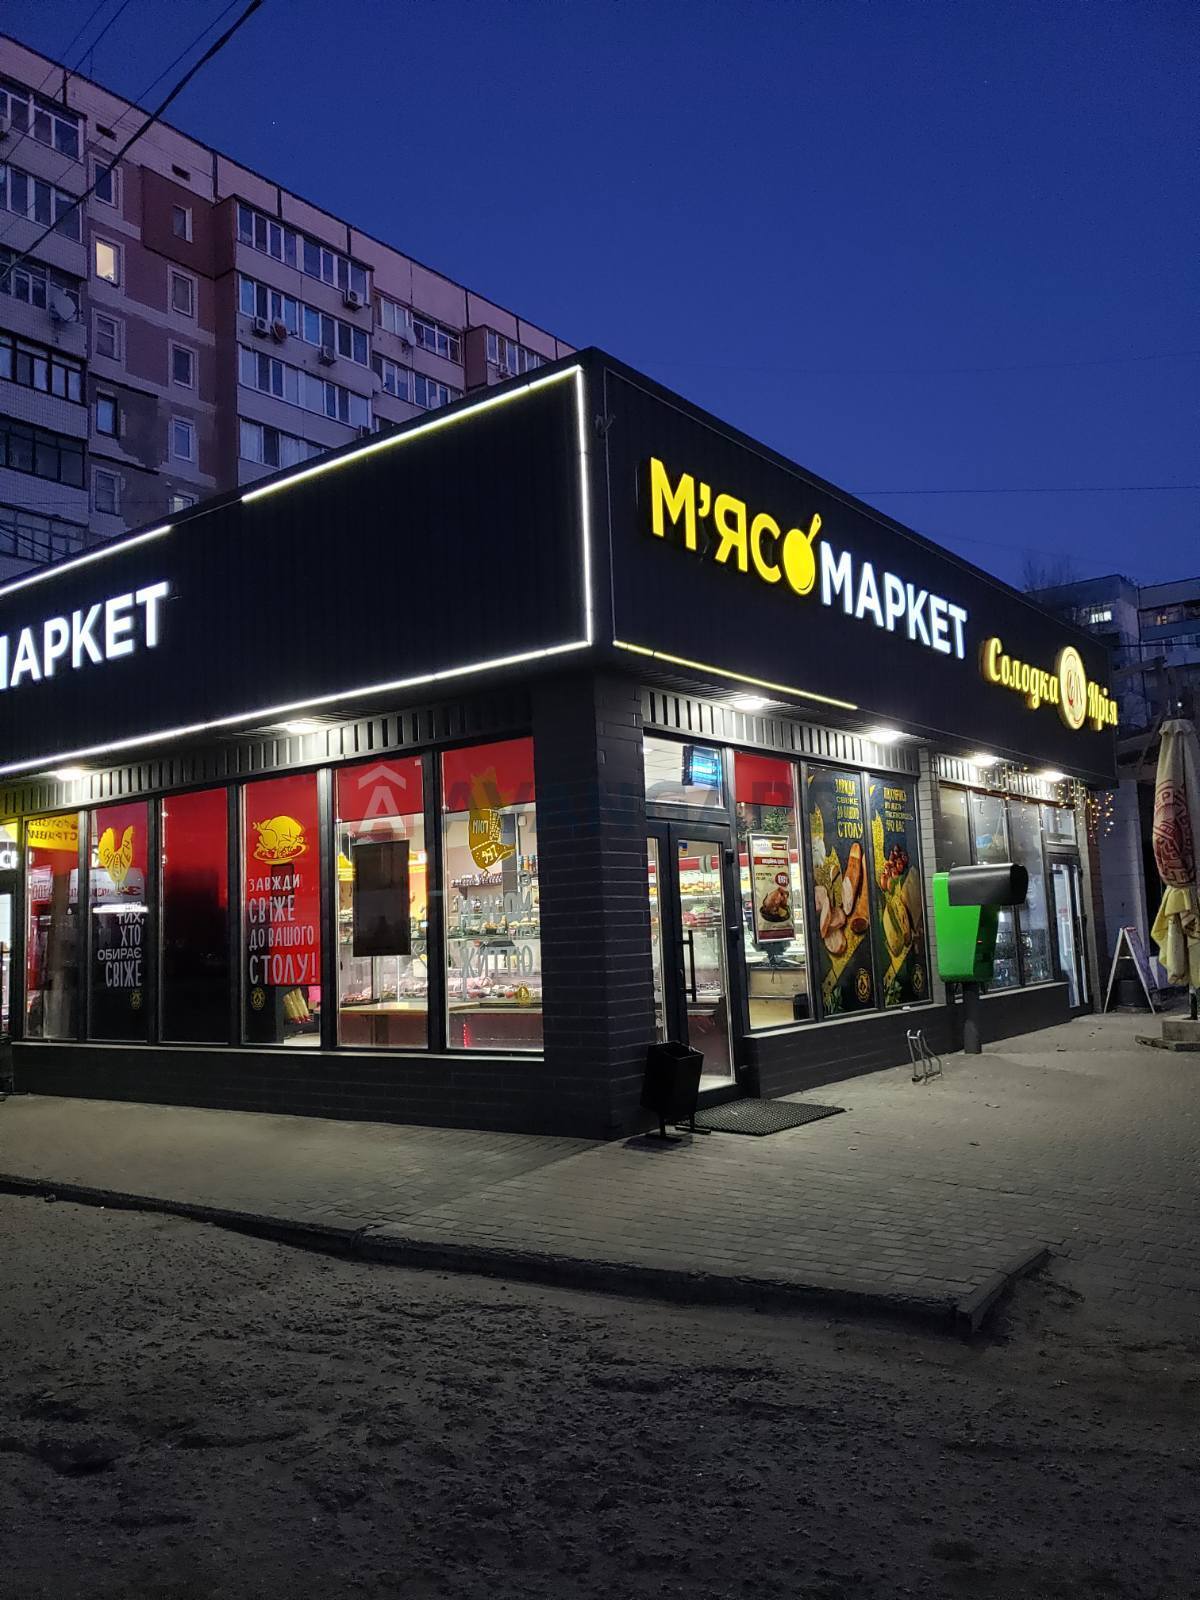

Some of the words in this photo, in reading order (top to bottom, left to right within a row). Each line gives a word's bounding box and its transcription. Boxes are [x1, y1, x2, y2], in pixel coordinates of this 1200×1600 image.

[0, 580, 170, 690] АРКЕТ
[985, 636, 1059, 710] Солодка
[1086, 680, 1119, 732] Мрія
[837, 821, 864, 840] СТОЛУ
[248, 872, 301, 892] ЗАВЖДИ
[248, 893, 296, 924] СВІЖЕ
[120, 923, 142, 947] ХТО
[248, 926, 265, 952] ДО
[267, 924, 315, 948] ВАШОГО
[97, 947, 143, 961] ОБИРАЄ
[249, 950, 318, 986] СТОЛУ!
[105, 959, 143, 988] СВІЖЕ
